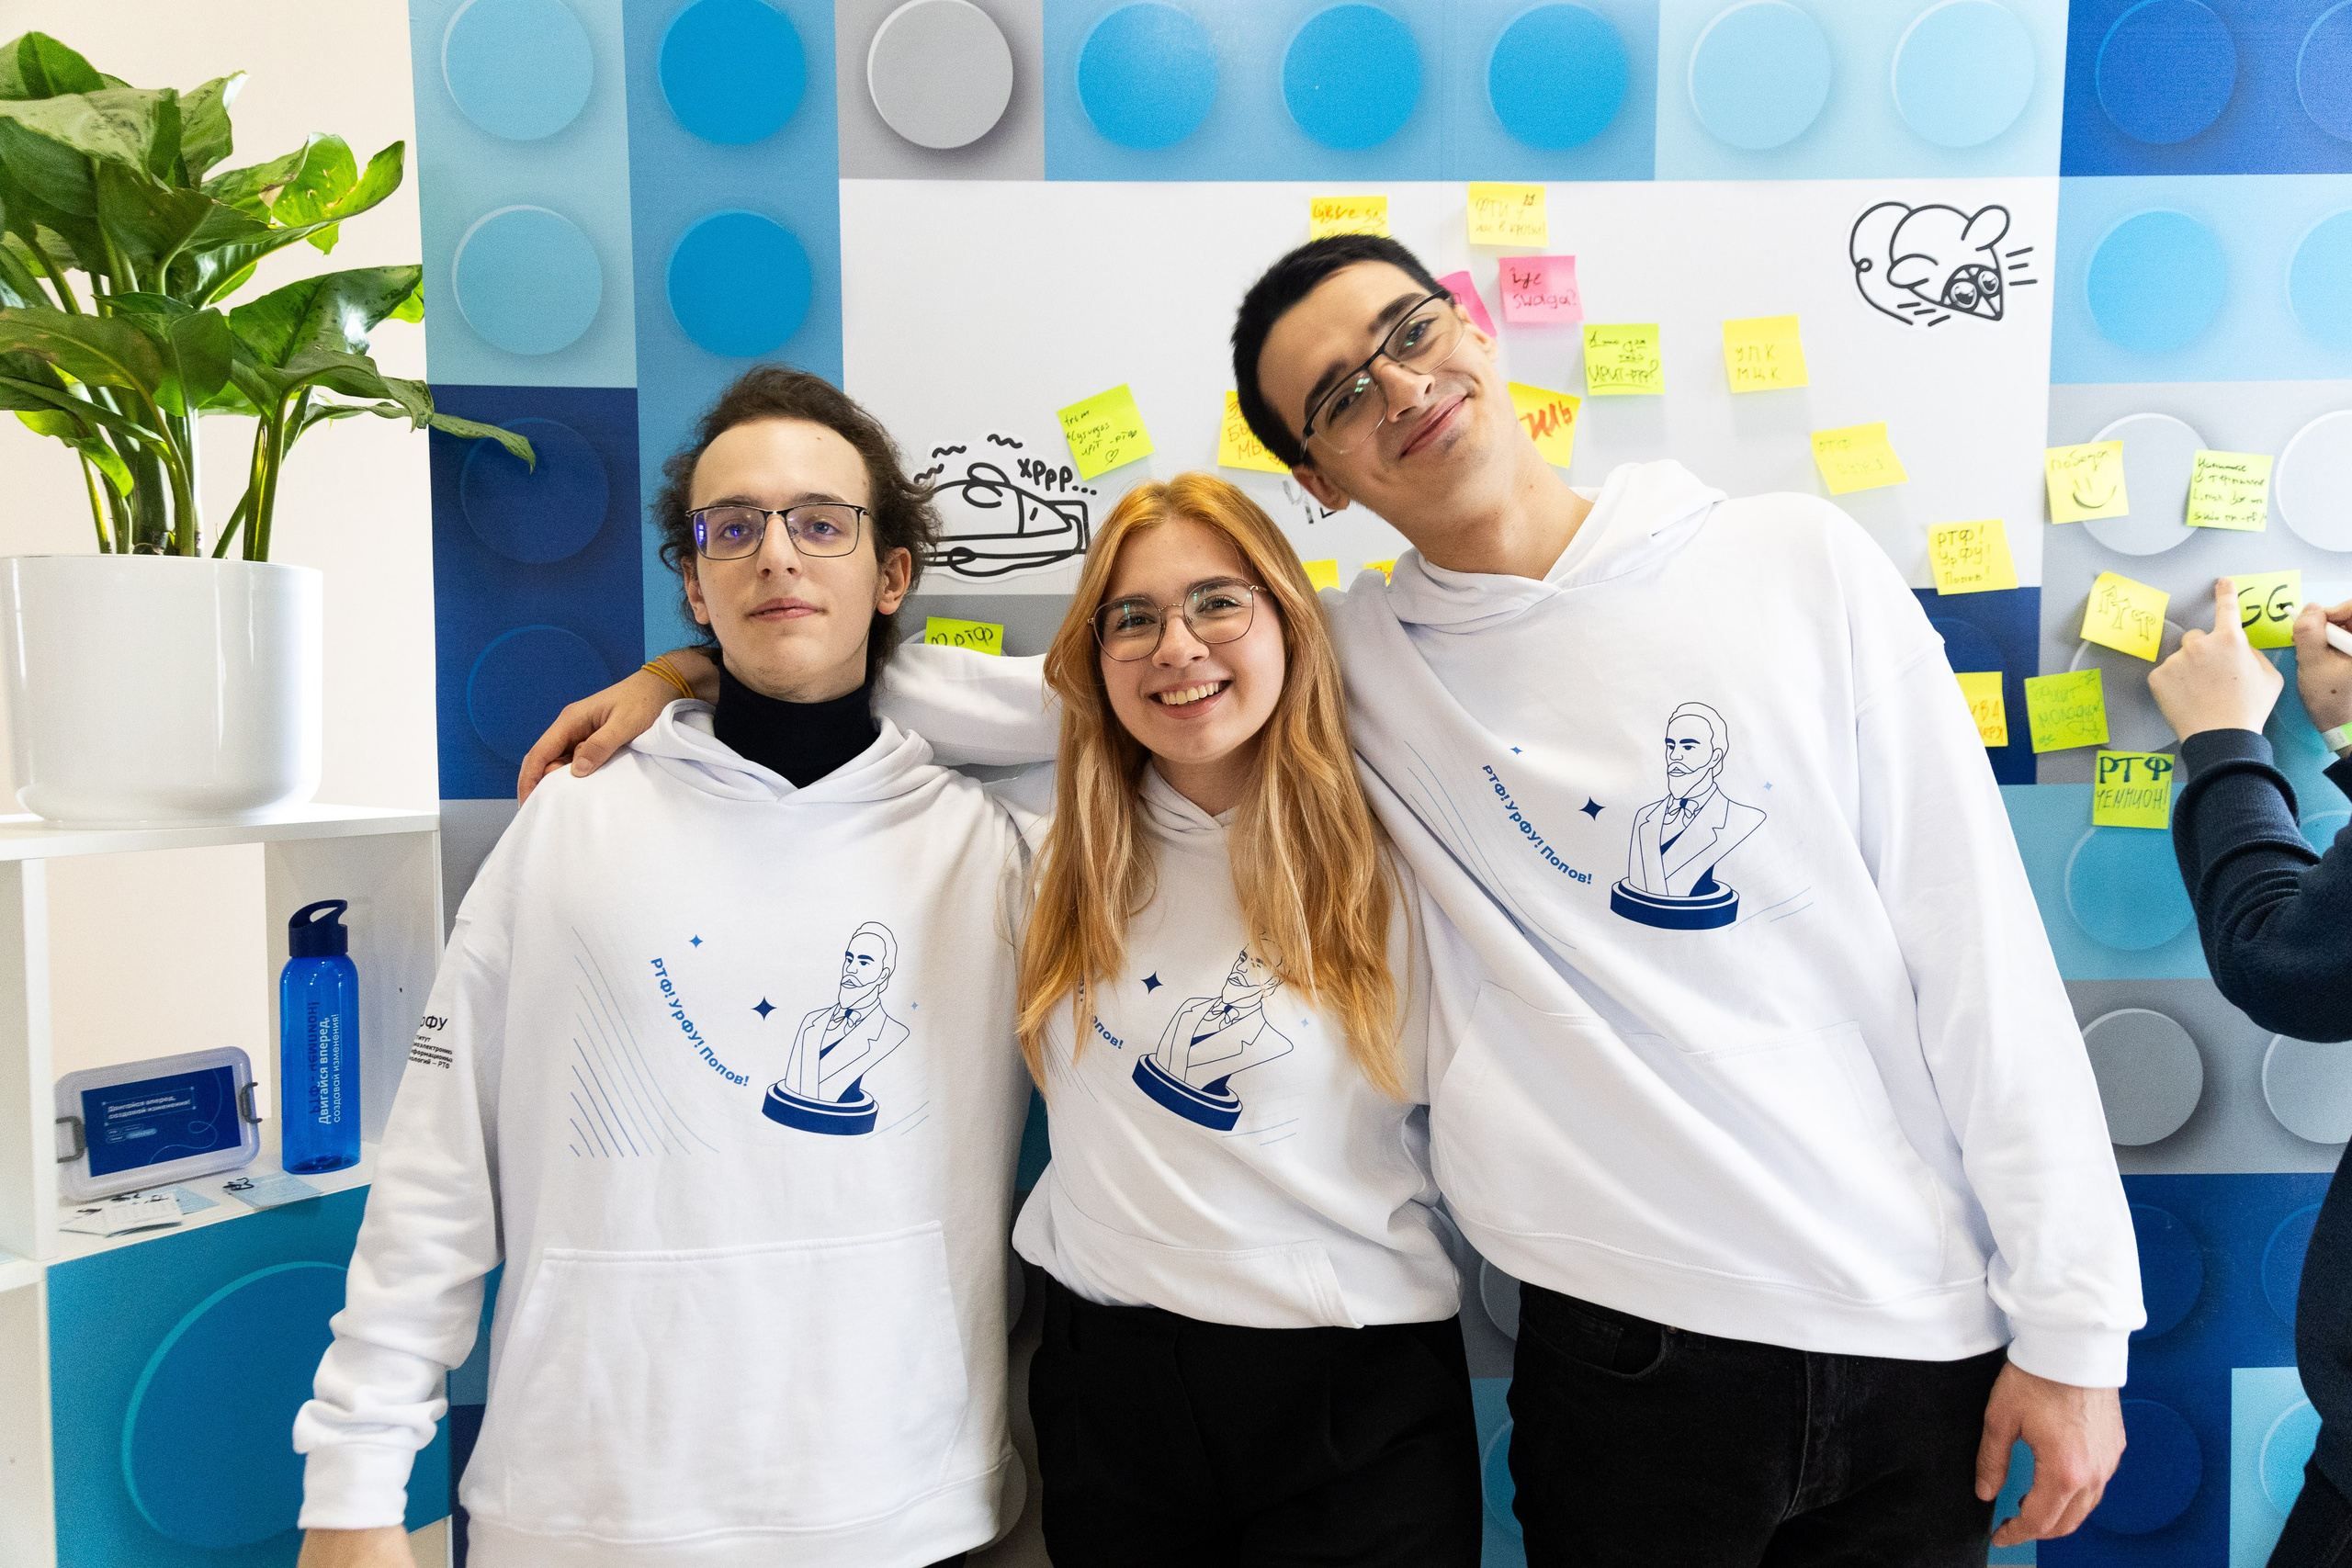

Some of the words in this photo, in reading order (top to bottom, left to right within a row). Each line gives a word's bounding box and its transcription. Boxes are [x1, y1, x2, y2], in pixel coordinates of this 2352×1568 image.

[2099, 755, 2173, 784] РТФ
[1482, 764, 1510, 803] РТФ!
[1505, 801, 1544, 849] УрФУ!
[1541, 845, 1592, 886] Попов!
[319, 1017, 332, 1065] вперед,
[331, 1013, 340, 1072] изменения!
[650, 957, 676, 998] РТФ!
[669, 997, 704, 1048] УрФУ!
[699, 1046, 750, 1088] Попов!
[317, 1066, 332, 1125] Двигайся
[331, 1073, 342, 1123] создавай
